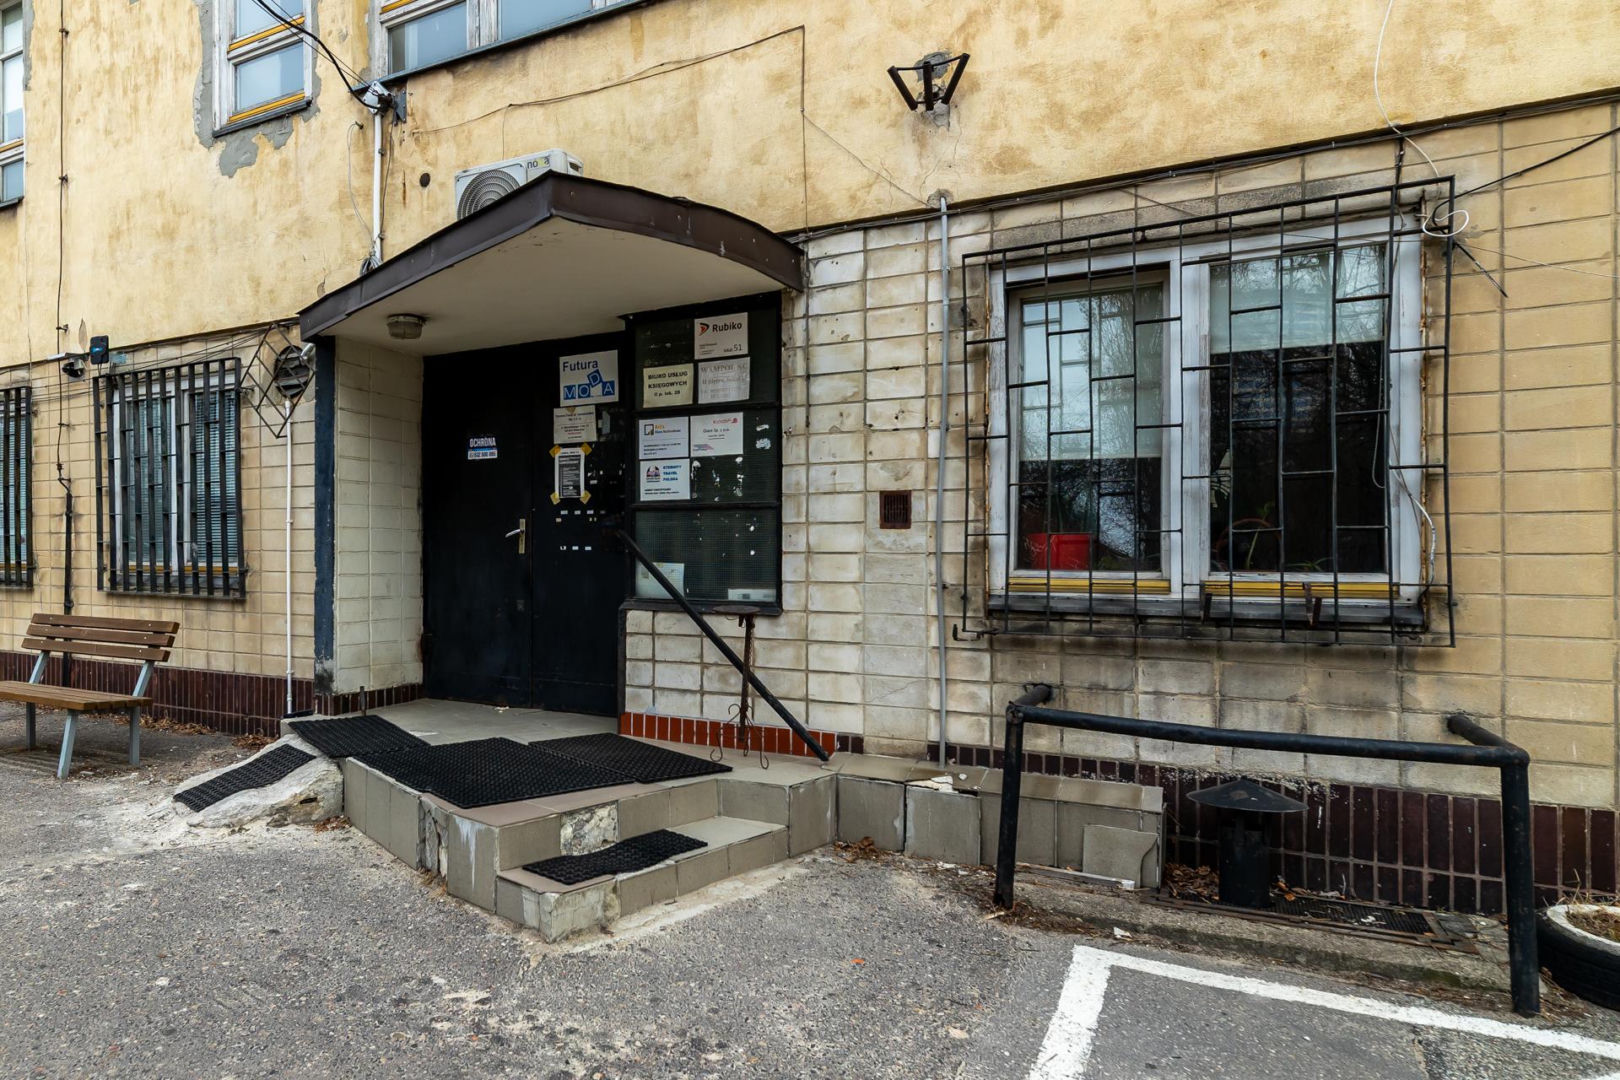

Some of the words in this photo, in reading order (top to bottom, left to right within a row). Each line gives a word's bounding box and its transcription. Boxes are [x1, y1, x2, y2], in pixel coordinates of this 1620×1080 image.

[712, 321, 743, 333] Rubiko
[562, 360, 599, 372] Futura
[563, 370, 615, 400] MODA
[469, 437, 497, 448] OCHRONA
